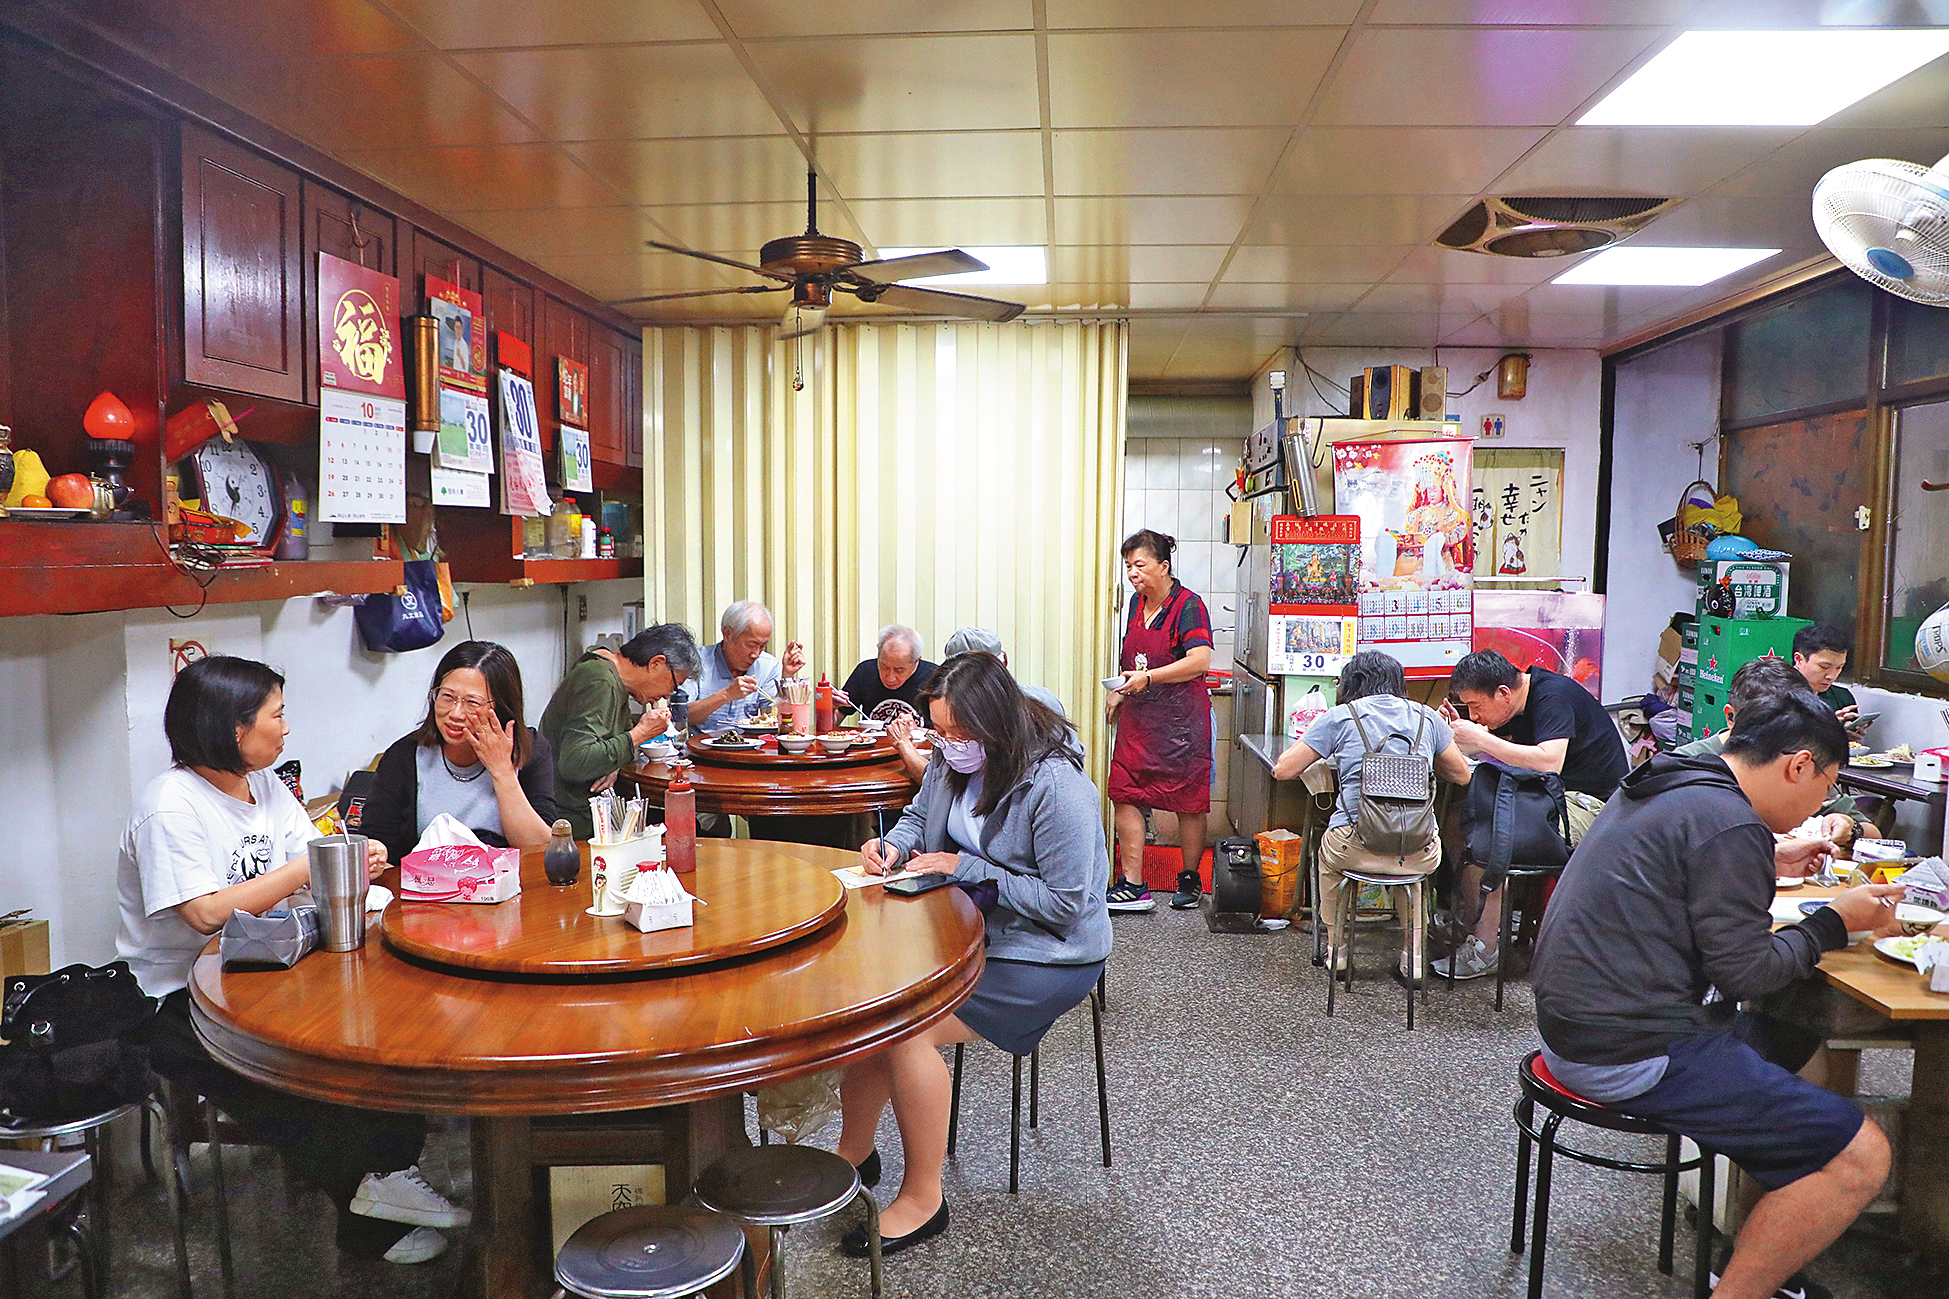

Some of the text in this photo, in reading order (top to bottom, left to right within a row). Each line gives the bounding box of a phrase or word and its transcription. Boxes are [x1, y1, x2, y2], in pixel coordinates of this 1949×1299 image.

[335, 300, 385, 385] 福
[361, 402, 374, 419] 10
[510, 380, 532, 439] 30
[466, 410, 488, 444] 30
[210, 444, 219, 456] 11
[222, 442, 232, 452] 12
[240, 448, 245, 458] 1
[576, 442, 588, 468] 30
[202, 460, 212, 472] 10
[250, 464, 258, 476] 2
[257, 484, 264, 497] 3
[1530, 475, 1548, 512] ニャン
[1501, 483, 1520, 526] 幸せ
[258, 506, 265, 518] 4
[252, 523, 259, 534] 5
[1392, 600, 1398, 612] 3
[1414, 600, 1420, 611] 4
[1435, 598, 1442, 610] 5
[1456, 597, 1462, 608] 6
[1392, 623, 1399, 634] 9
[1411, 623, 1424, 634] 10
[1434, 622, 1443, 634] 11
[1454, 622, 1468, 633] 12
[1303, 655, 1324, 668] 30
[1699, 669, 1724, 684] Heineken
